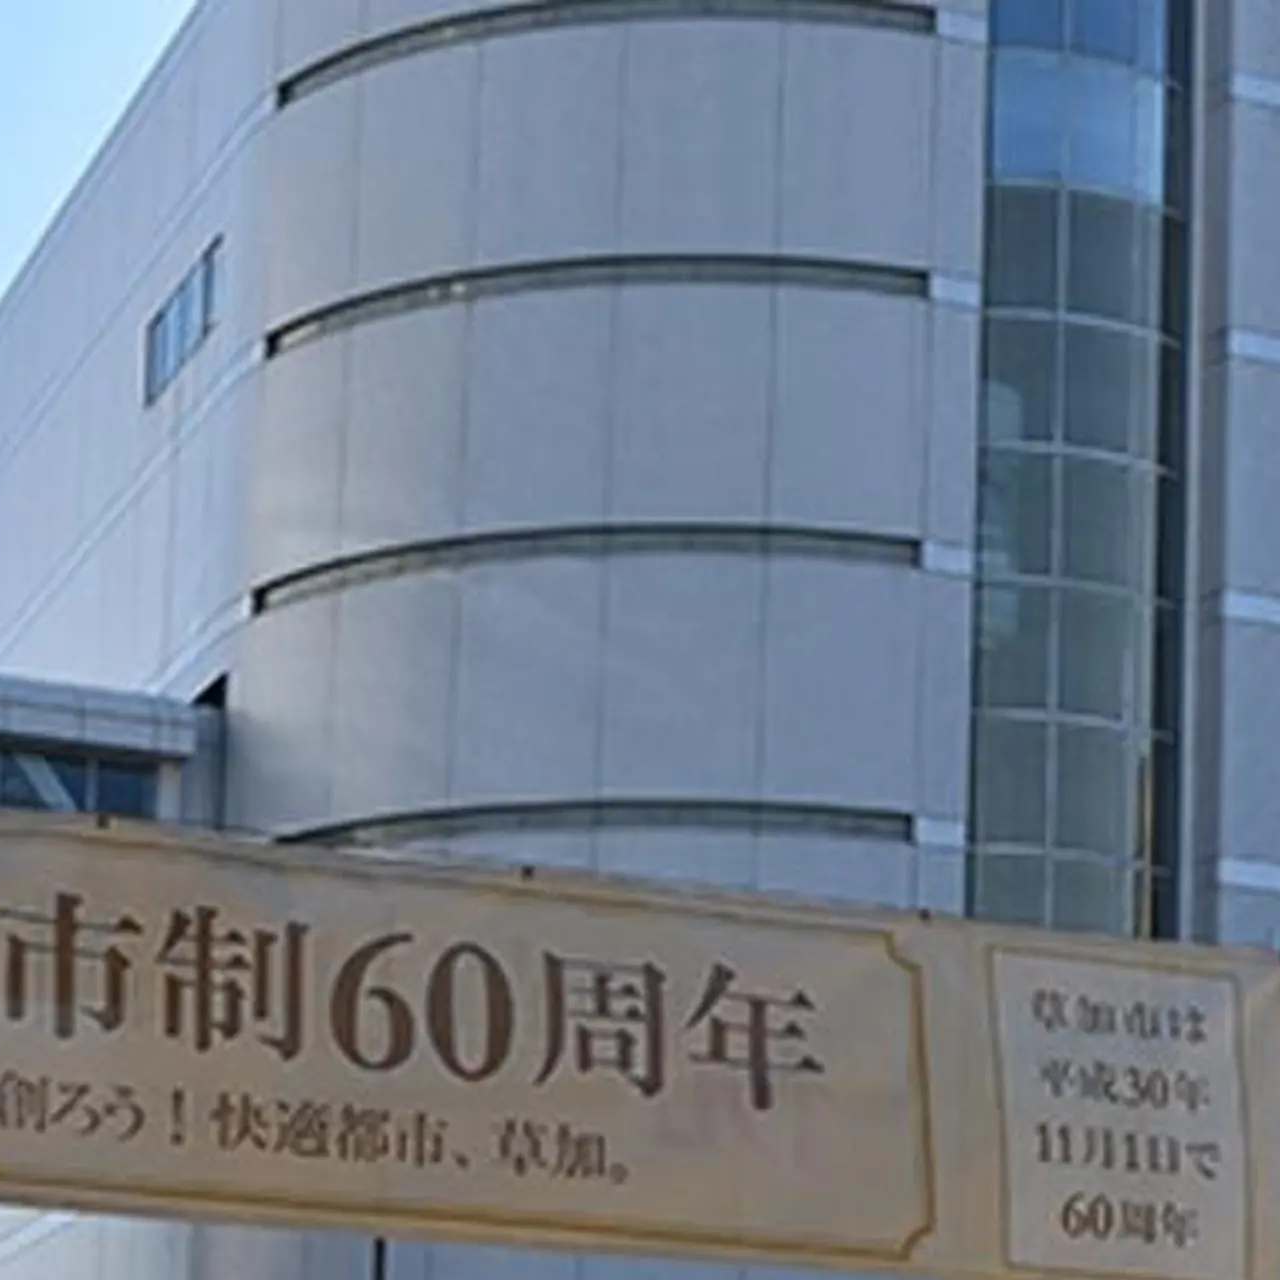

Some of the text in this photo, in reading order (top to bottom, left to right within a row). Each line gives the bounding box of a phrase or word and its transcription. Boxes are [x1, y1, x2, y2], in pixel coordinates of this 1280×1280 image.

[1031, 988, 1208, 1045] 草加市は
[1040, 1058, 1212, 1115] 平成30年
[1035, 1121, 1222, 1183] 11月1日で
[1061, 1189, 1200, 1248] 60周年
